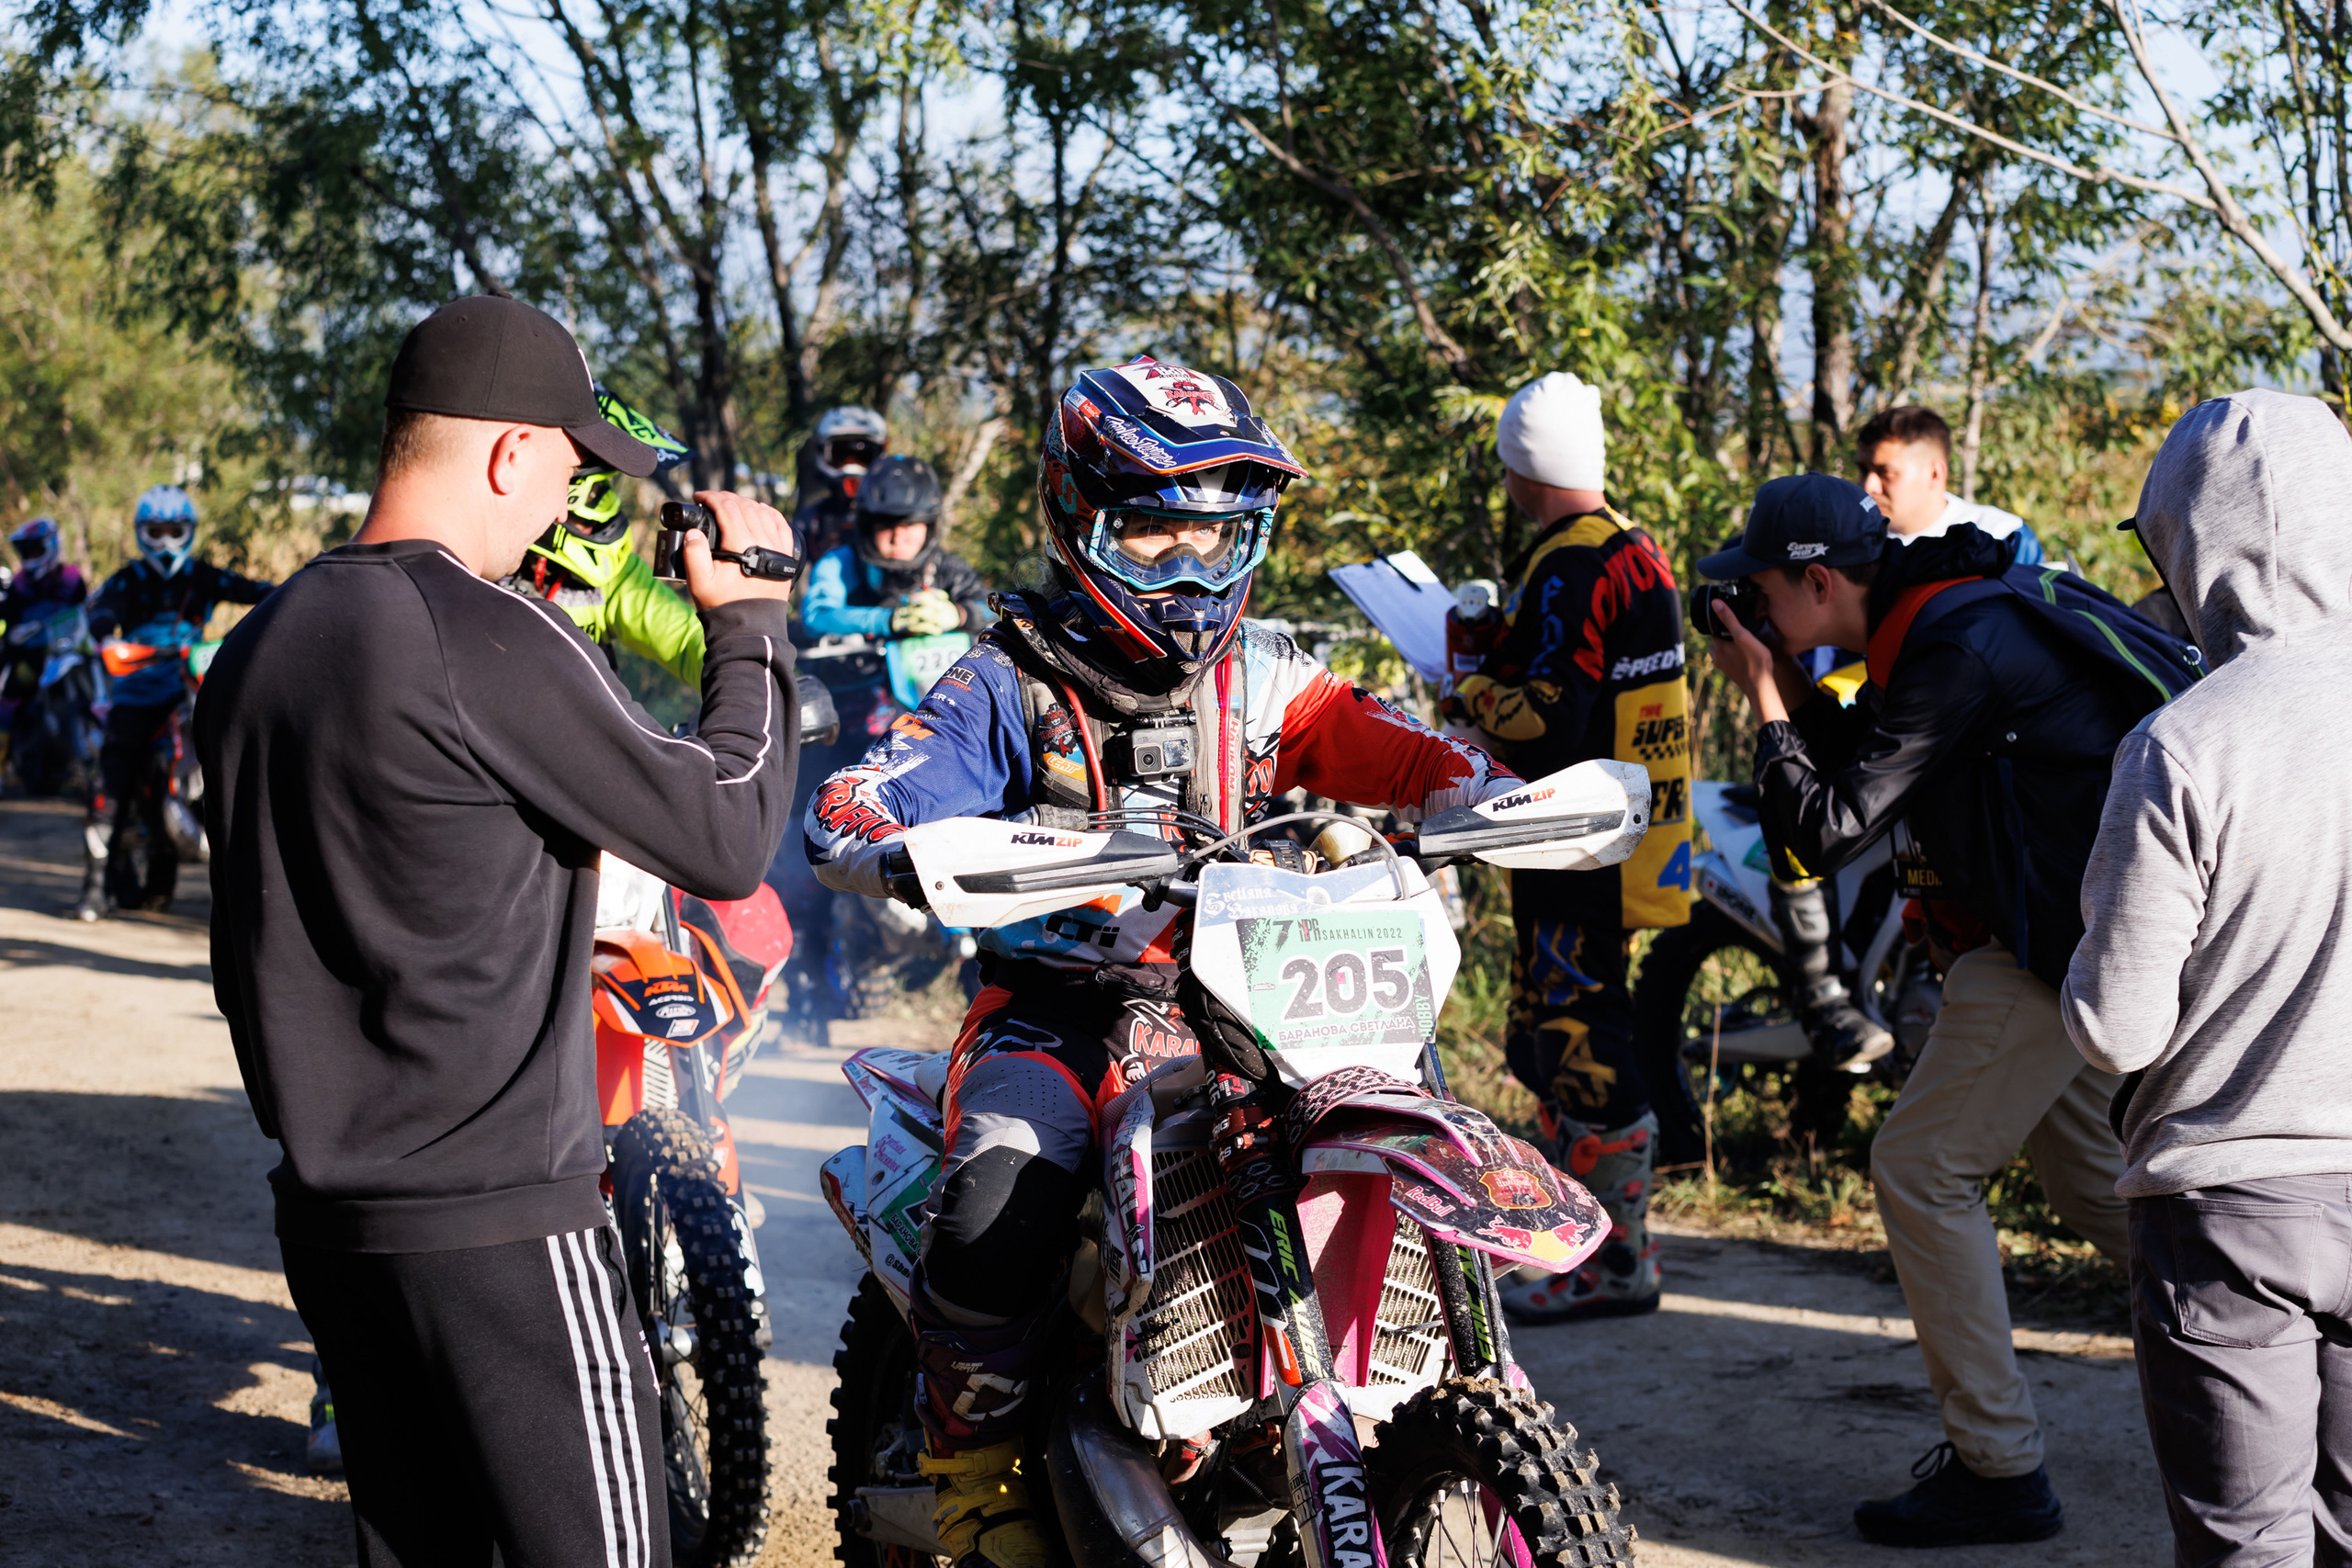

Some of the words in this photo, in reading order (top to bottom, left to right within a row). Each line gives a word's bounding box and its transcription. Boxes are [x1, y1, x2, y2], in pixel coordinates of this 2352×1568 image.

[1047, 755, 1082, 774] LEATT
[1322, 929, 1374, 941] SAKHALIN
[1376, 927, 1403, 939] 2022
[644, 980, 689, 997] KTM
[1282, 948, 1411, 1021] 205
[1278, 1023, 1346, 1042] БАРАНОВА
[1350, 1016, 1416, 1036] СВЕТЛАНА
[1414, 994, 1431, 1038] HOBBY
[1134, 1021, 1201, 1058] KARA
[889, 1213, 919, 1252] БАРАНОВА
[1268, 1208, 1300, 1283] ERIC
